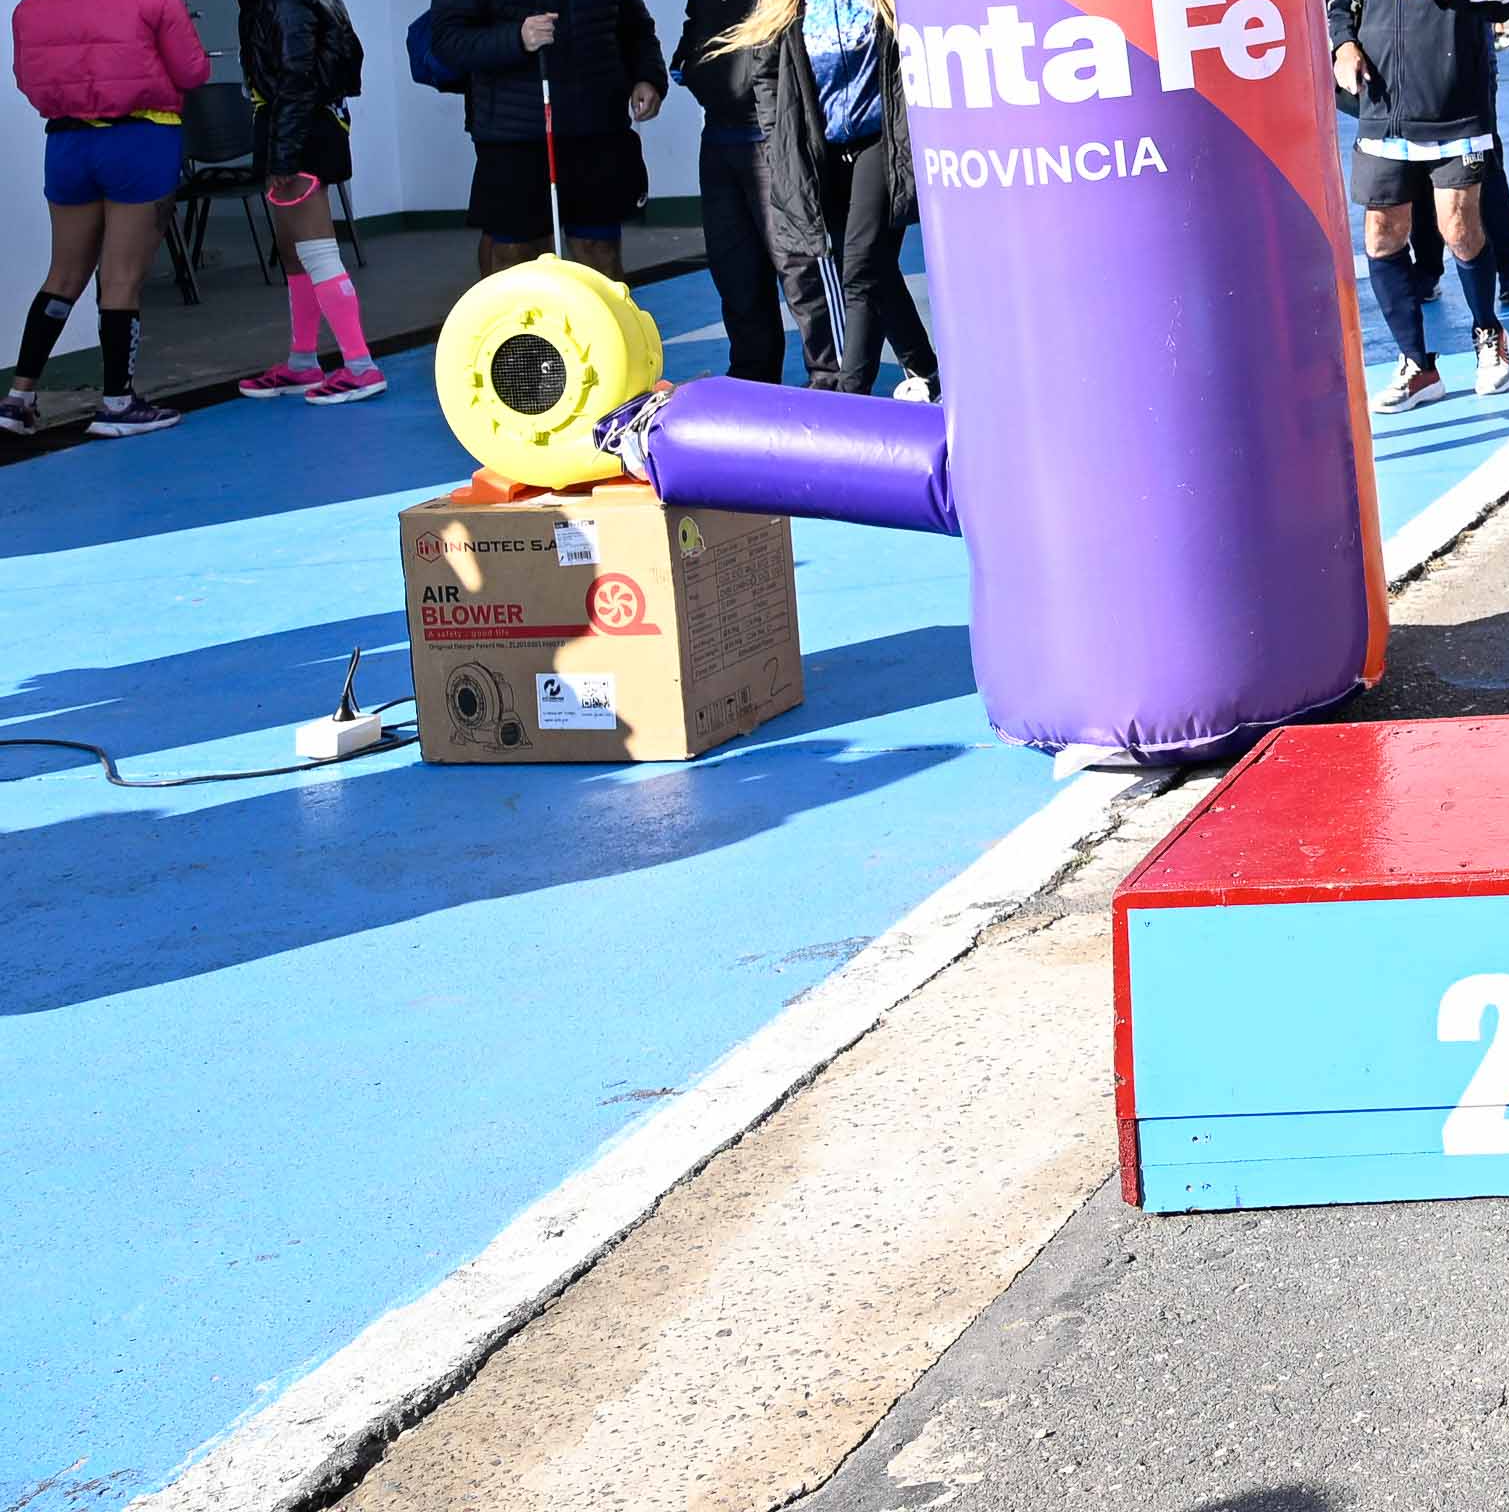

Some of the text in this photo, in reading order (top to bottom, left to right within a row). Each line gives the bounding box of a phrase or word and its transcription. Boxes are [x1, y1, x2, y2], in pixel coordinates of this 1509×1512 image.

[899, 4, 1132, 110] anta
[924, 136, 1168, 188] PROVINCIA
[445, 539, 525, 553] INNOTEC
[422, 585, 460, 604] AIR
[421, 604, 524, 626] BLOWER
